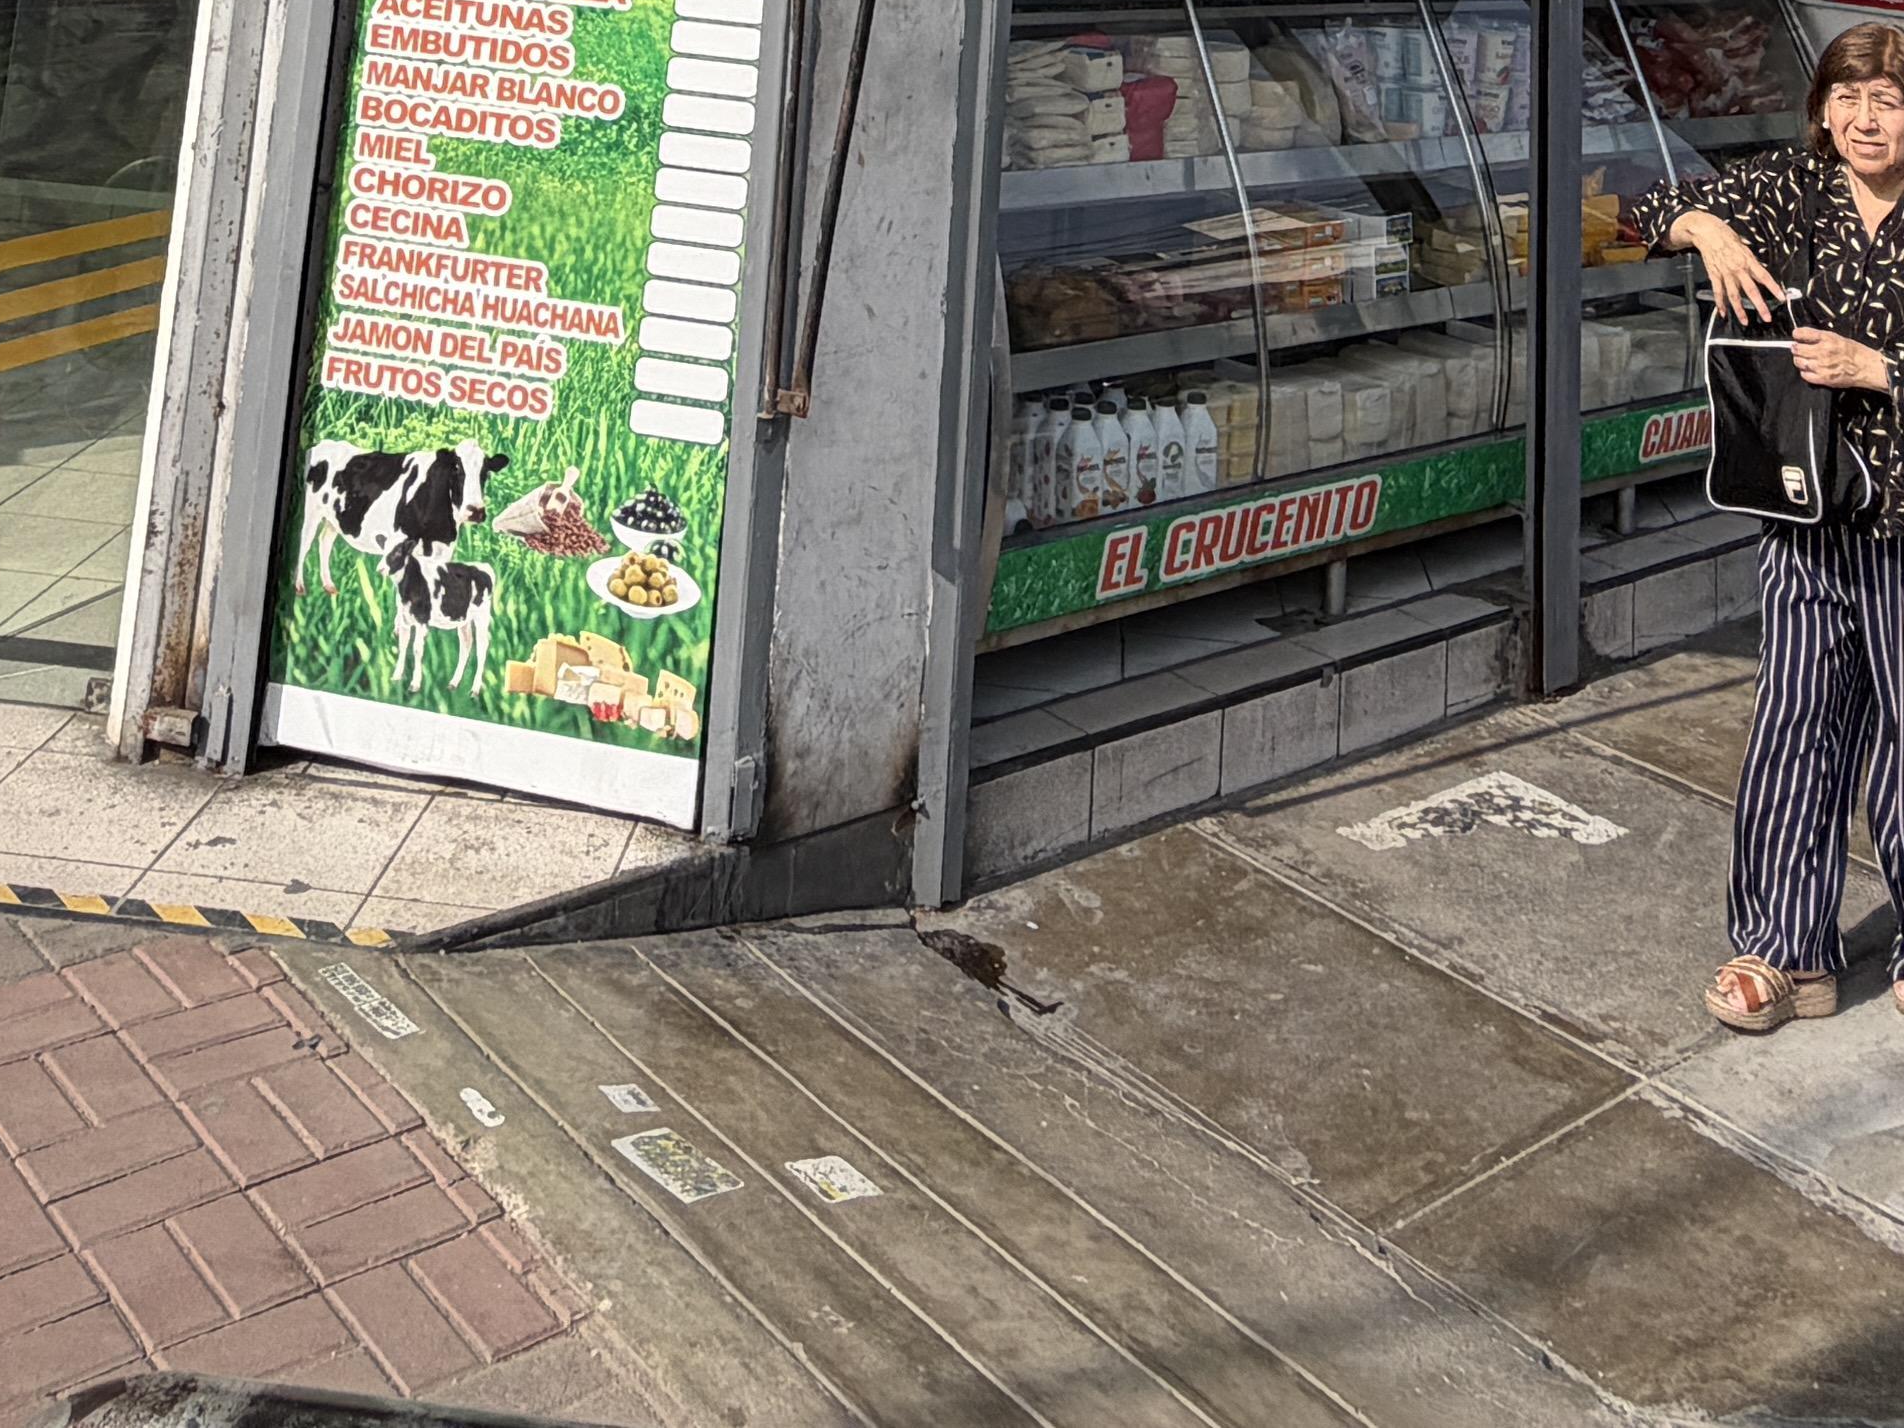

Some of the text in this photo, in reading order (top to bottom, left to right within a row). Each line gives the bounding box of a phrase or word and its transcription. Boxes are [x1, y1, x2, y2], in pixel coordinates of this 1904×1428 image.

[370, 24, 570, 71] EMBUTIDOS
[366, 60, 621, 116] MANJAR BLANCO
[361, 95, 557, 144] BOCADITOS
[358, 132, 431, 165] MIEL
[354, 168, 507, 212] CHORIZO
[350, 203, 465, 243] CECINA
[341, 241, 543, 291] FRANKFURTER
[339, 273, 621, 338] SALCHICHA HUACHANA
[332, 316, 562, 373] JAMON DEL PAÍS
[325, 355, 549, 414] FRUTOS SECOS
[1101, 527, 1147, 594] EL
